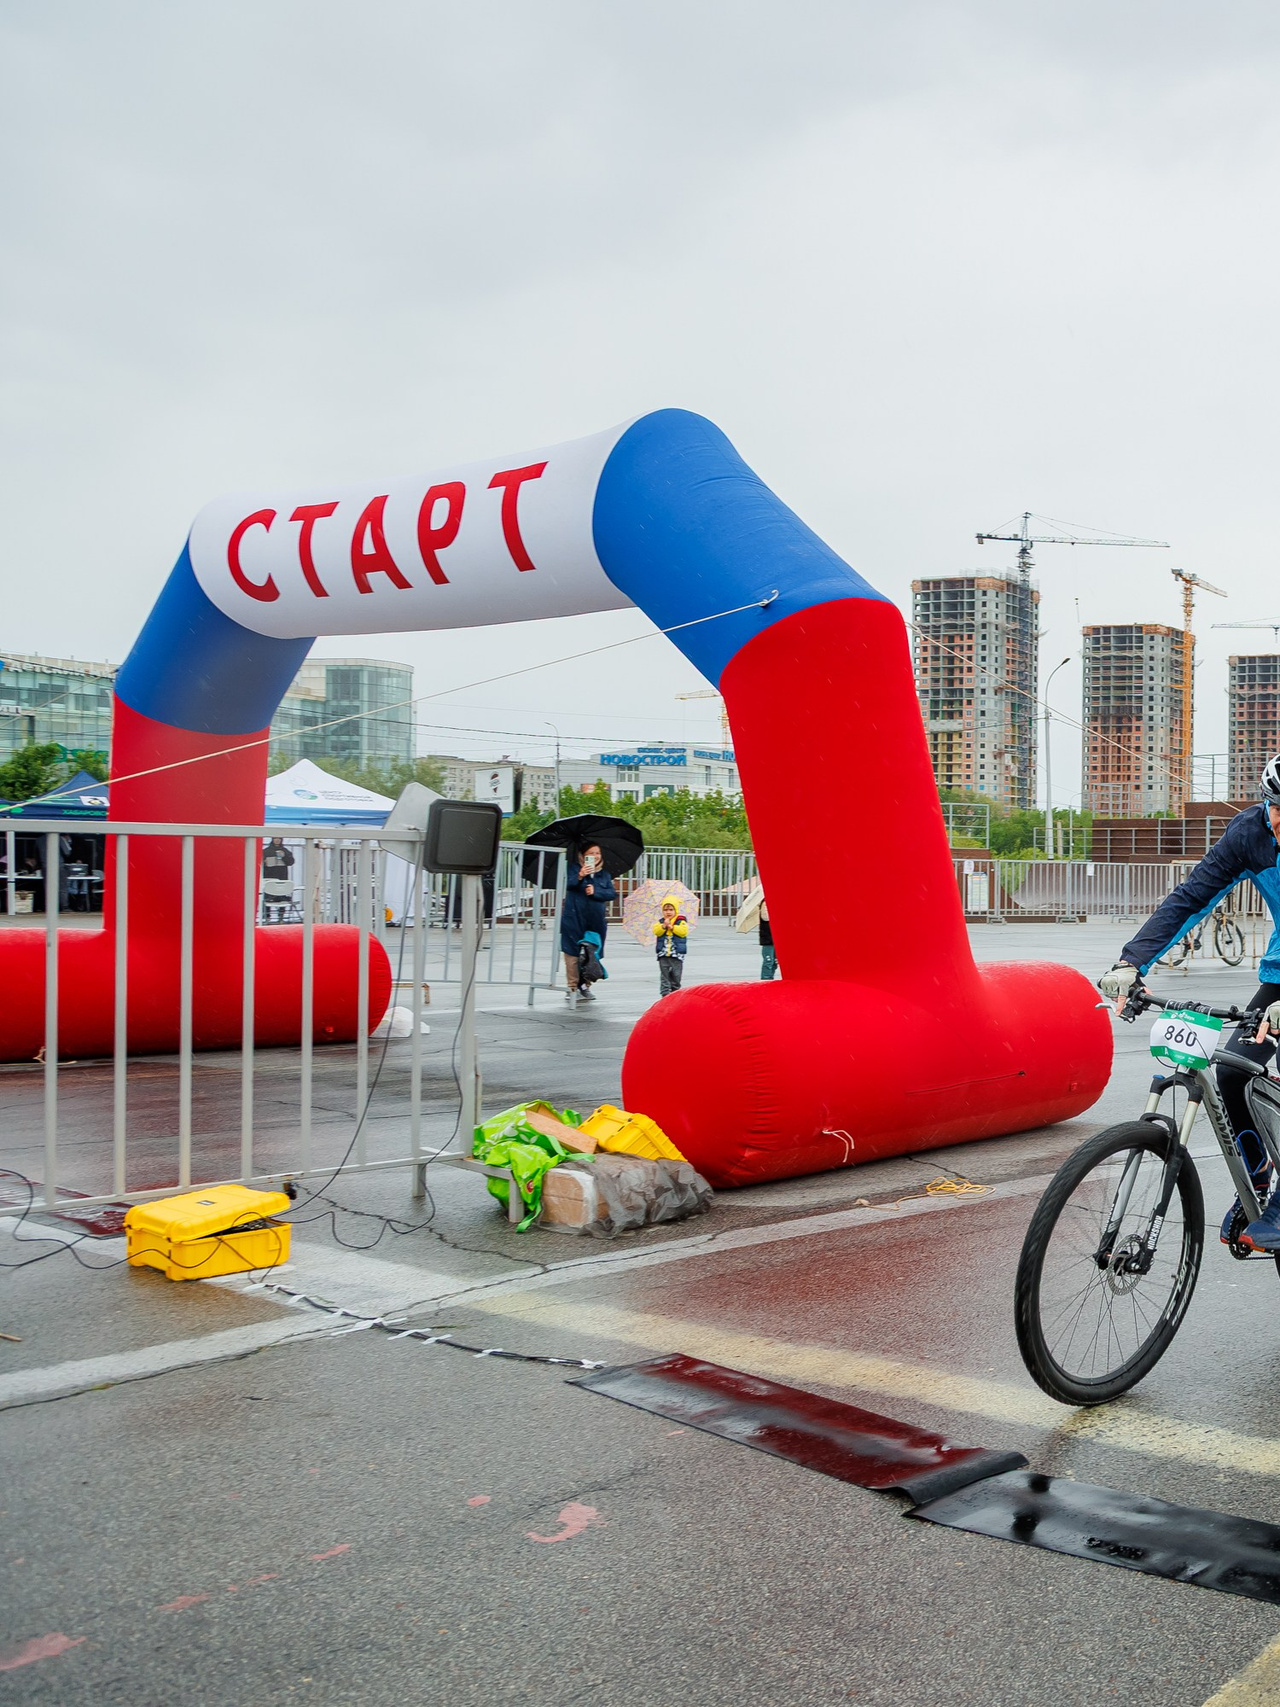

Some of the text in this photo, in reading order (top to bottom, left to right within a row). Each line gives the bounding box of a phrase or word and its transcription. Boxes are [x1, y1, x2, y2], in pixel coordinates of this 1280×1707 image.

[227, 461, 549, 602] СТАРТ
[600, 754, 687, 766] НОВОСТРОЙ
[1164, 1025, 1198, 1047] 860
[1207, 1097, 1237, 1157] JAMIS
